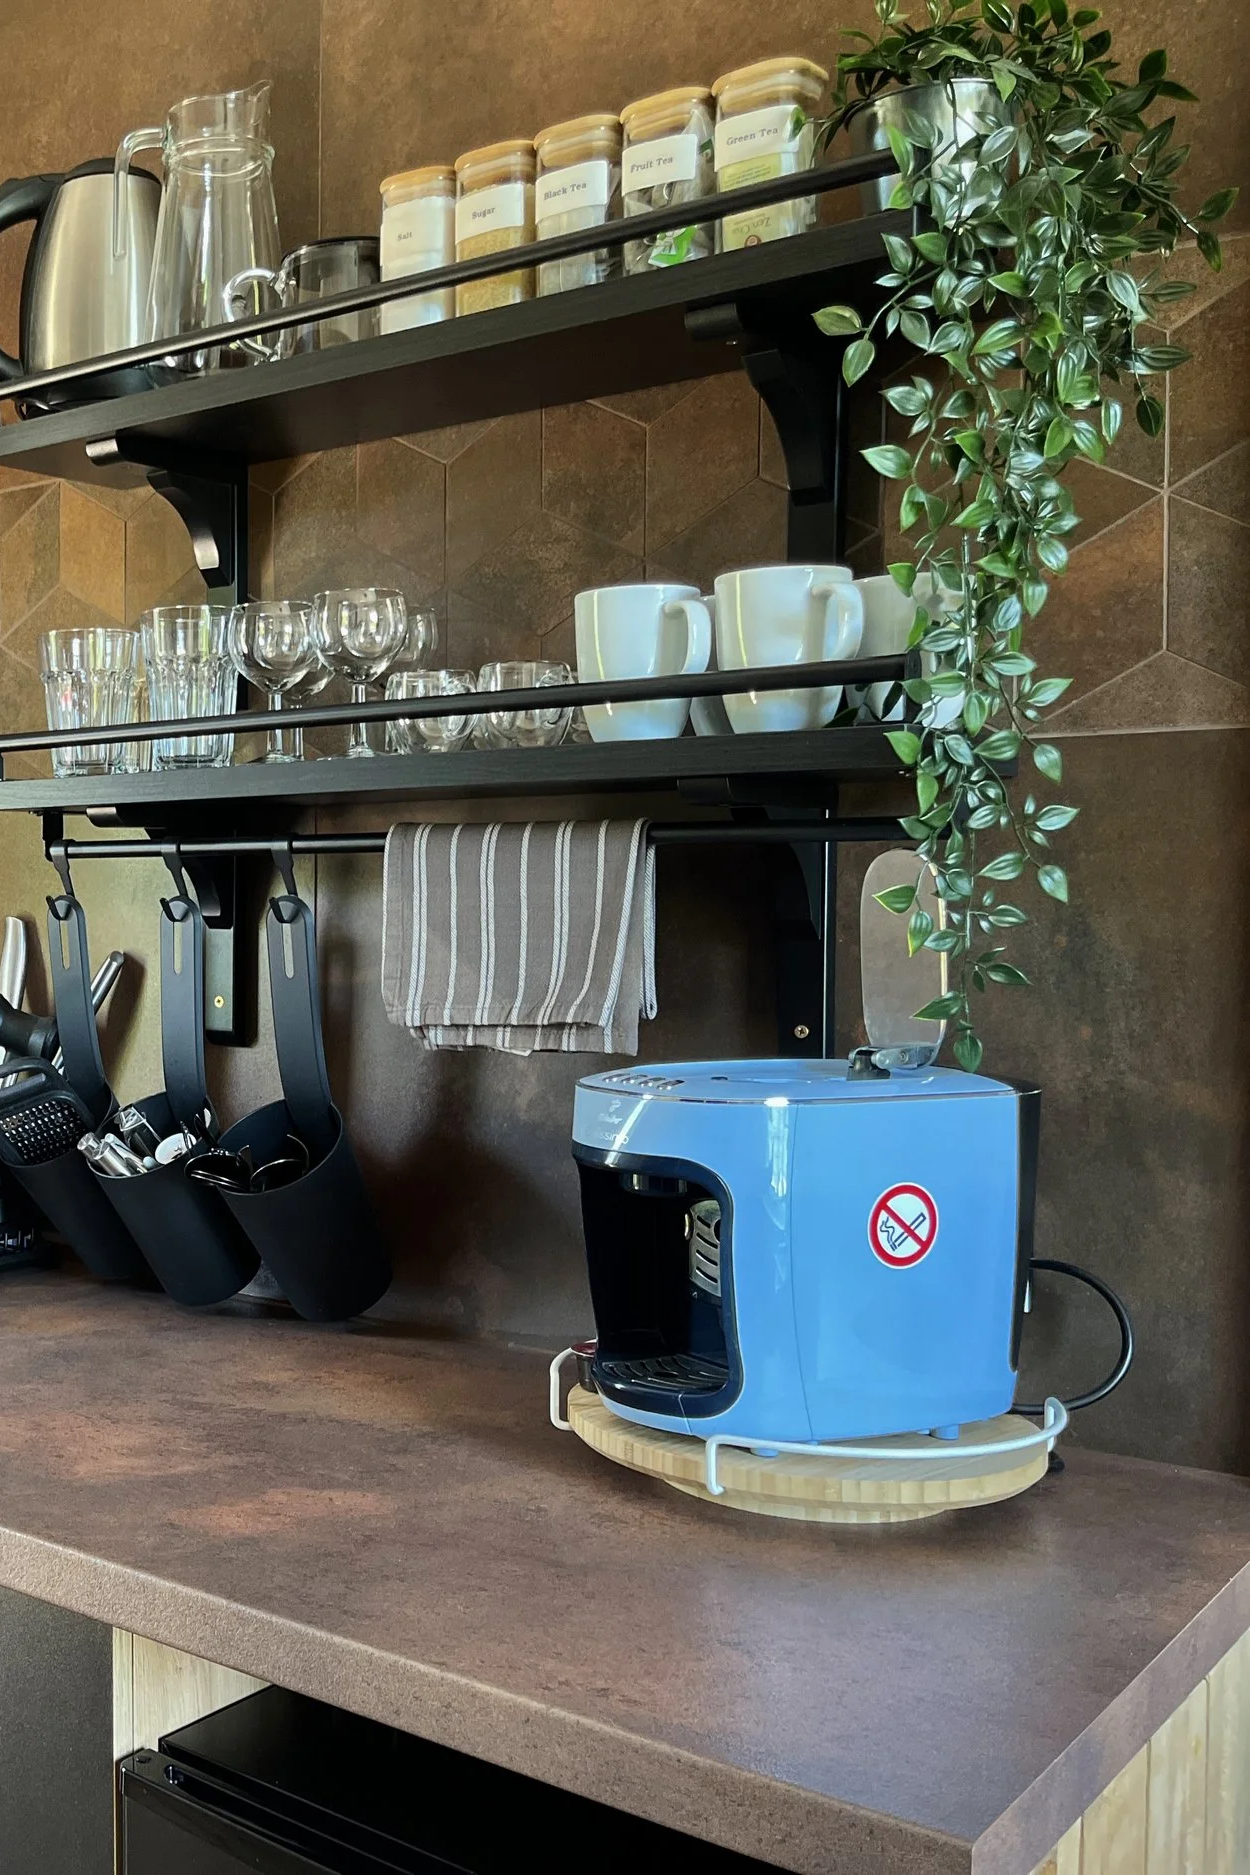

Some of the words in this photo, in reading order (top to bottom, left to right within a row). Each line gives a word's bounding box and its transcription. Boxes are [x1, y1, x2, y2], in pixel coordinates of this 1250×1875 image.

[726, 133, 756, 146] Green
[760, 128, 778, 138] Tea
[630, 161, 653, 173] Fruit
[656, 157, 673, 166] Tea
[543, 188, 567, 200] Black
[570, 182, 587, 192] Tea
[471, 207, 496, 220] Sugar
[397, 231, 412, 242] Salt
